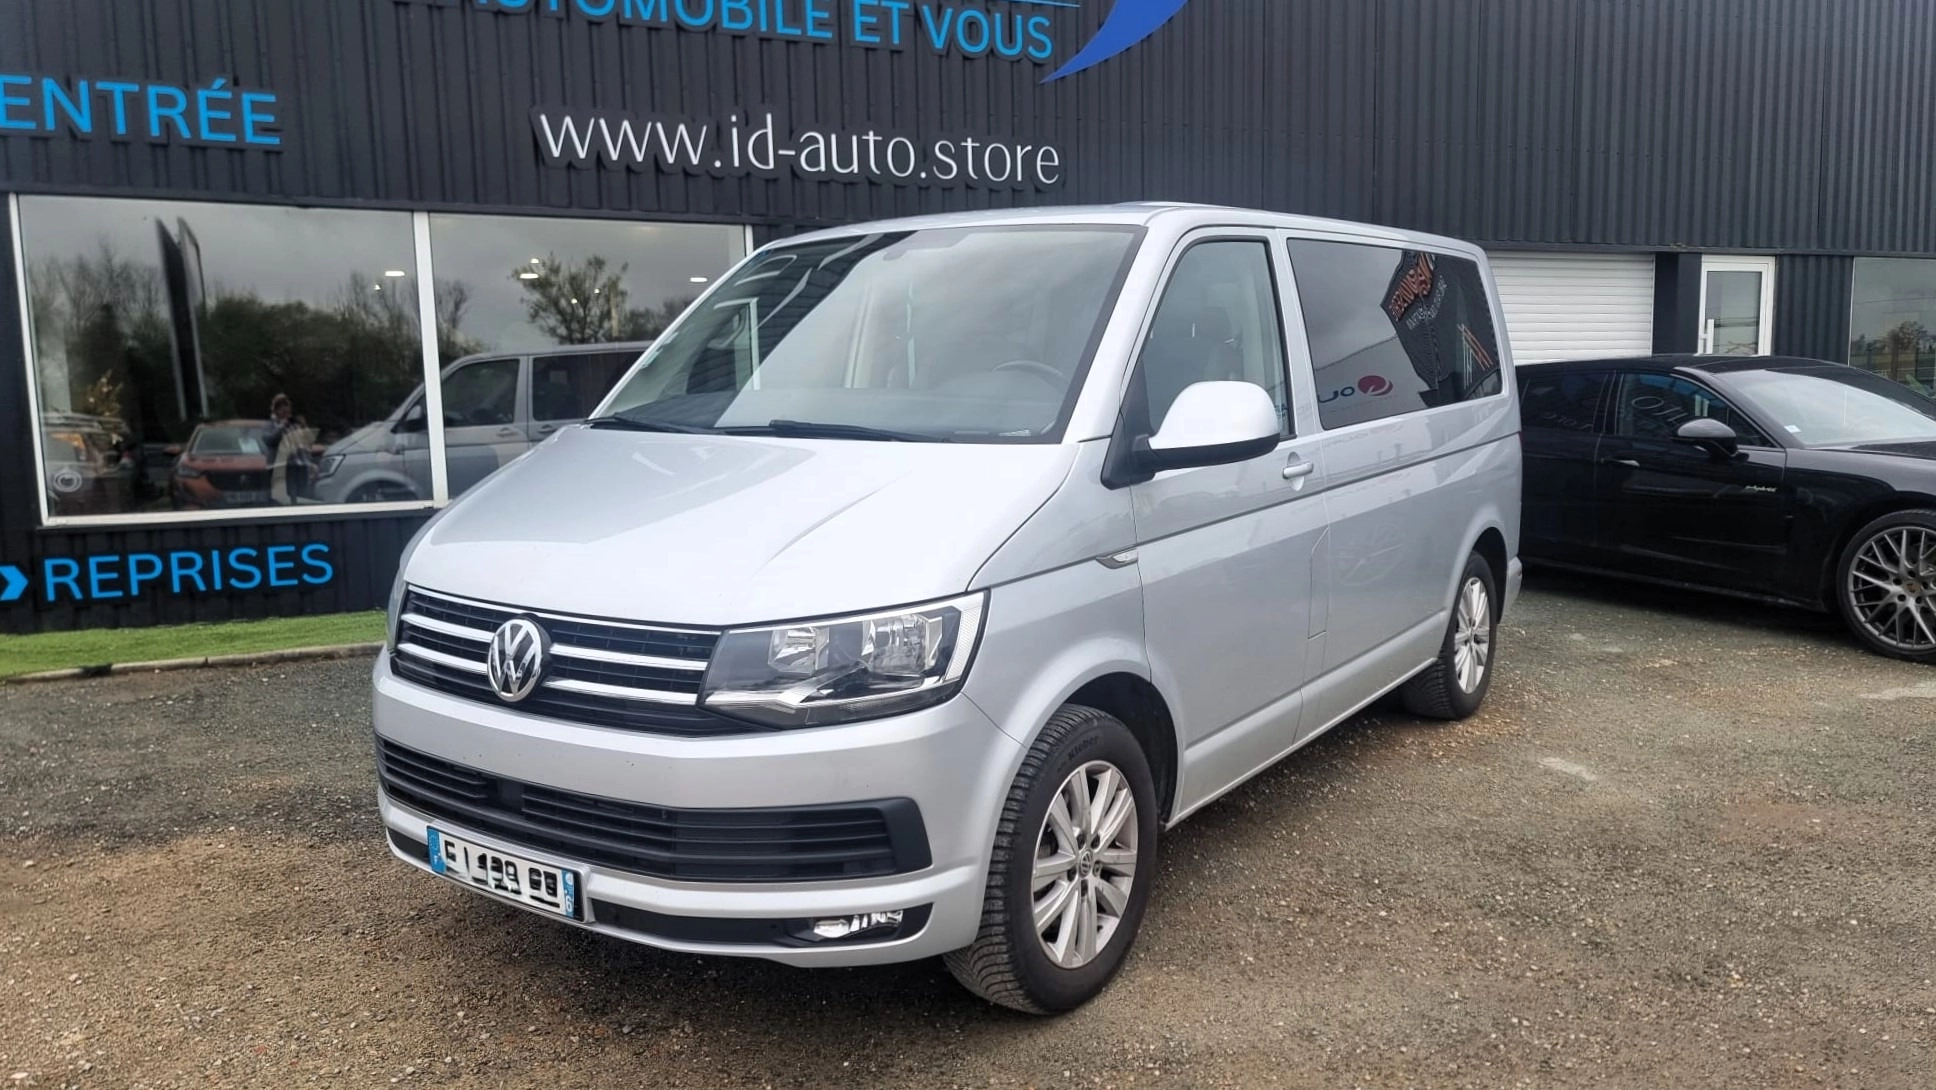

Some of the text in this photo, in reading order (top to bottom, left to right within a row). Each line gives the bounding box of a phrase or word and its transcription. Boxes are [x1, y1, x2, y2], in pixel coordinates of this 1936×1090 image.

[478, 0, 1054, 59] MOBILE ET VOUS
[0, 74, 281, 146] ENTRÉE
[539, 113, 1060, 184] www.id-auto.store
[43, 543, 334, 602] REPRISES
